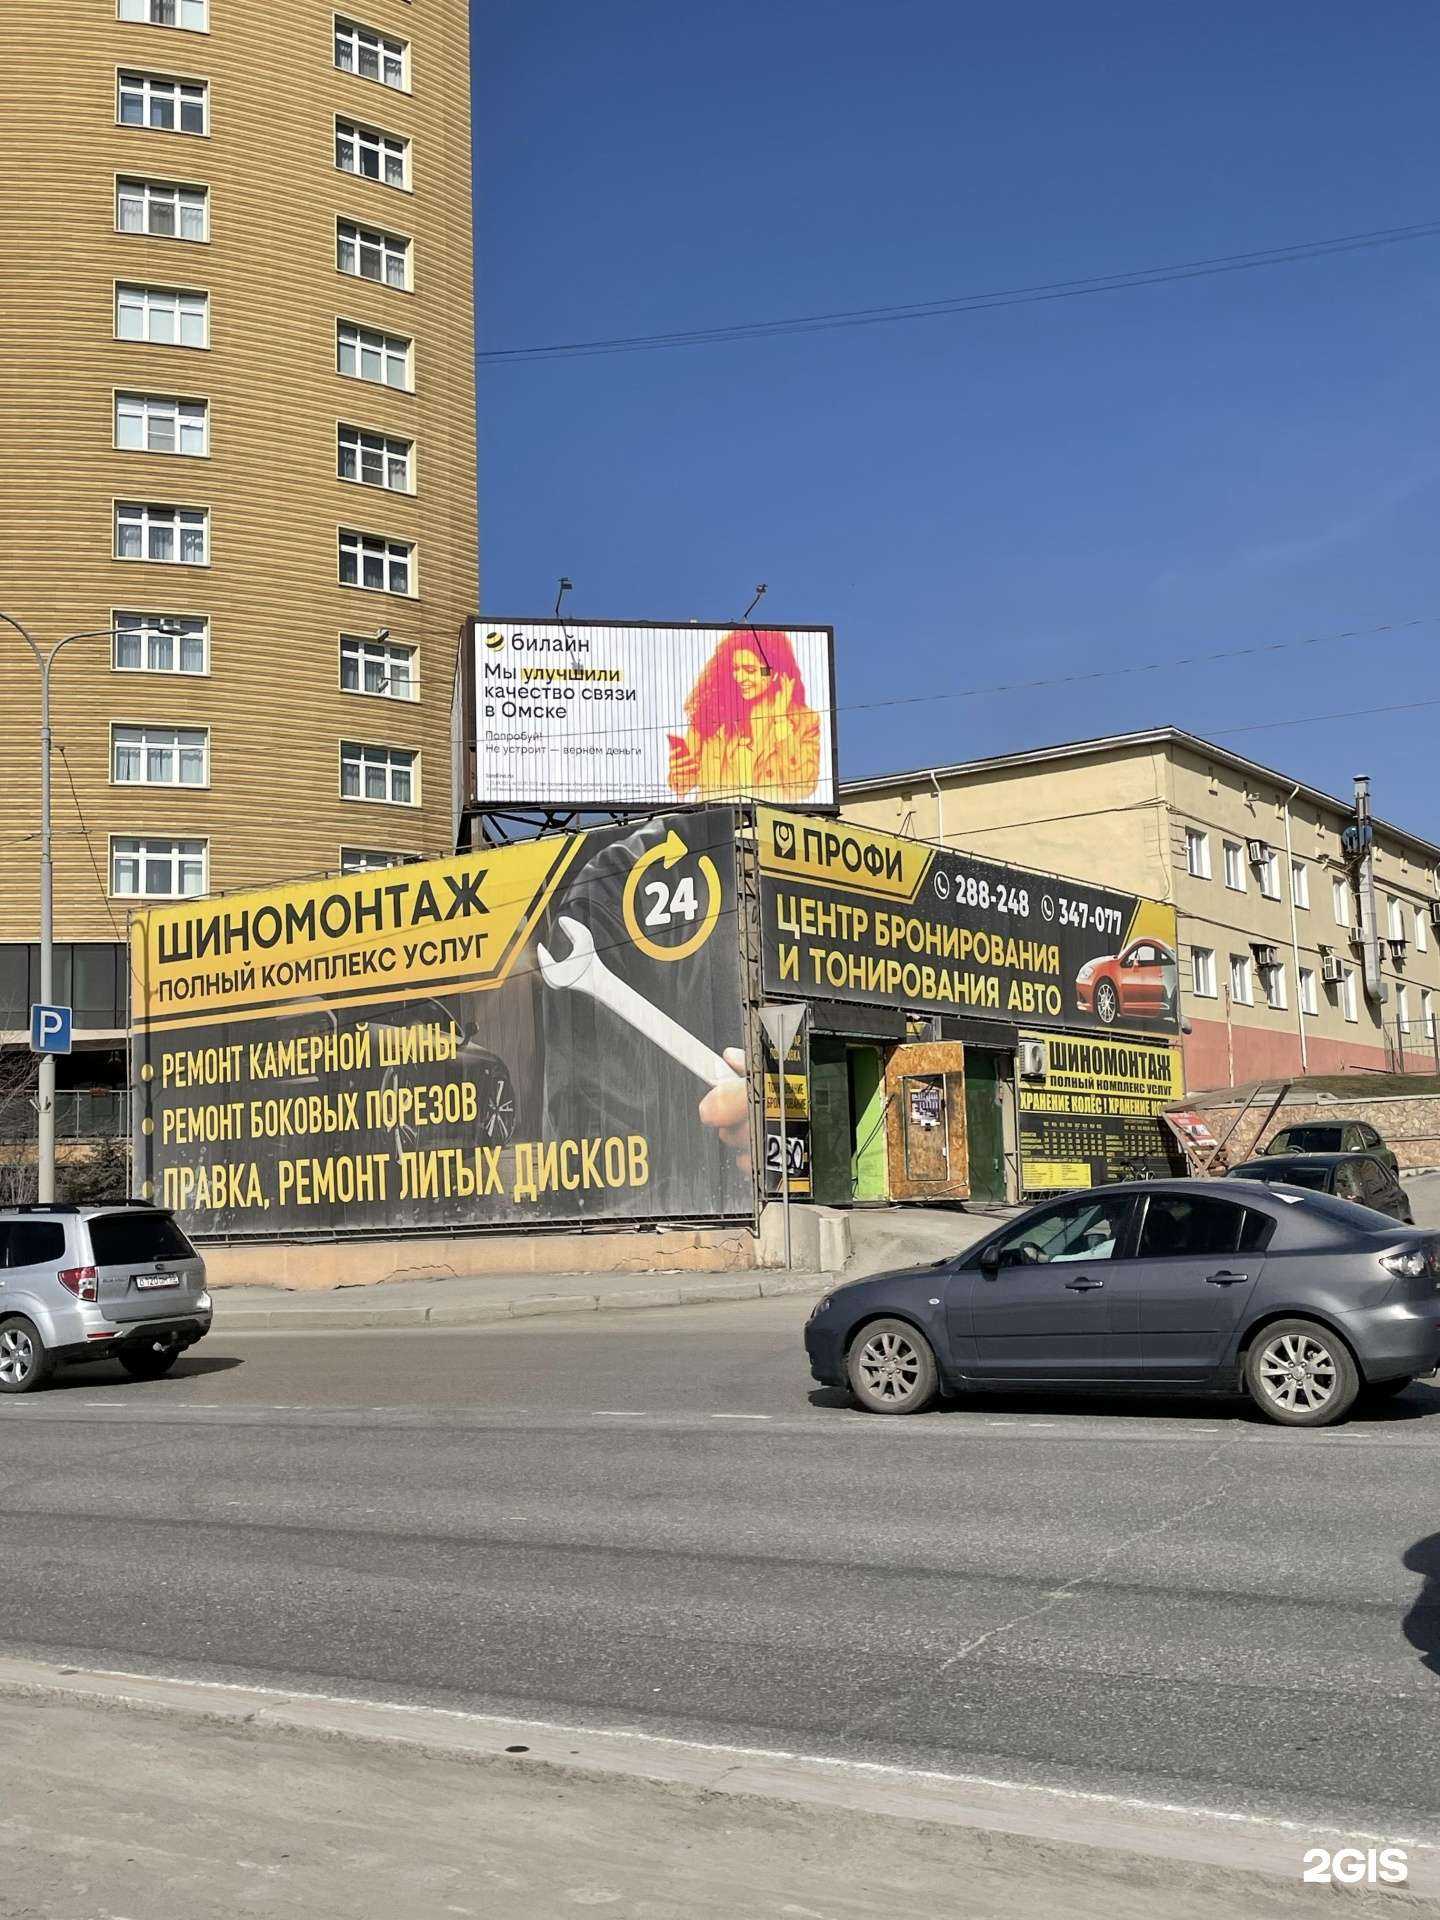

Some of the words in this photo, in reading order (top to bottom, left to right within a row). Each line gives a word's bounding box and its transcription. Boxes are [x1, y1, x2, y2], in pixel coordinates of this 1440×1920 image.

[511, 632, 590, 653] билайн
[484, 662, 517, 680] Мы
[523, 667, 620, 685] улучшили
[484, 685, 575, 700] качество
[581, 687, 636, 701] связи
[485, 705, 496, 718] в
[501, 701, 567, 719] Омске
[485, 730, 543, 743] Попробуй!
[485, 744, 500, 755] Не
[503, 745, 546, 757] устроит
[605, 746, 642, 757] деньги
[802, 827, 903, 882] ПРОФИ
[157, 868, 490, 965] ШИНОМОНТАЖ
[644, 876, 699, 926] 24
[954, 874, 1030, 918] 288-248
[1058, 897, 1122, 936] 347-077
[776, 892, 868, 942] ЦЕНТР
[875, 911, 1060, 975] БРОНИРОВАНИЯ
[158, 960, 256, 1003] ПОЛНЫЙ
[261, 946, 397, 988] КОМПЛЕКС
[404, 932, 489, 970] УСЛУГ
[777, 943, 800, 982] И
[809, 947, 1000, 1009] ТОНИРОВАНИЯ
[1007, 979, 1062, 1017] АВТО
[162, 1045, 243, 1089] РЕМОНТ
[249, 1021, 371, 1081] КАМЕРНОЙ
[378, 1020, 458, 1067] ШИНЫ
[1049, 1040, 1172, 1082] ШИНОМОНТАЖ
[1019, 1091, 1070, 1112] ХРАНЕНИЕ
[1108, 1097, 1151, 1116] ХРАНЕНИЕ
[1151, 1101, 1168, 1117] КО
[1050, 1075, 1095, 1090] ПОЛНЫЙ
[1096, 1079, 1145, 1095] КОМПЛЕКС
[1146, 1083, 1172, 1097] УСЛУГ
[162, 1102, 245, 1145] РЕМОНТ
[250, 1091, 360, 1139] БОКОВЫХ
[366, 1081, 478, 1129] ПОРЕЗОВ
[163, 1162, 270, 1211] ПРАВКА,
[278, 1153, 390, 1206] РЕМОНТ
[399, 1145, 504, 1200] ЛИТЫХ
[513, 1134, 650, 1204] ДИСКОВ
